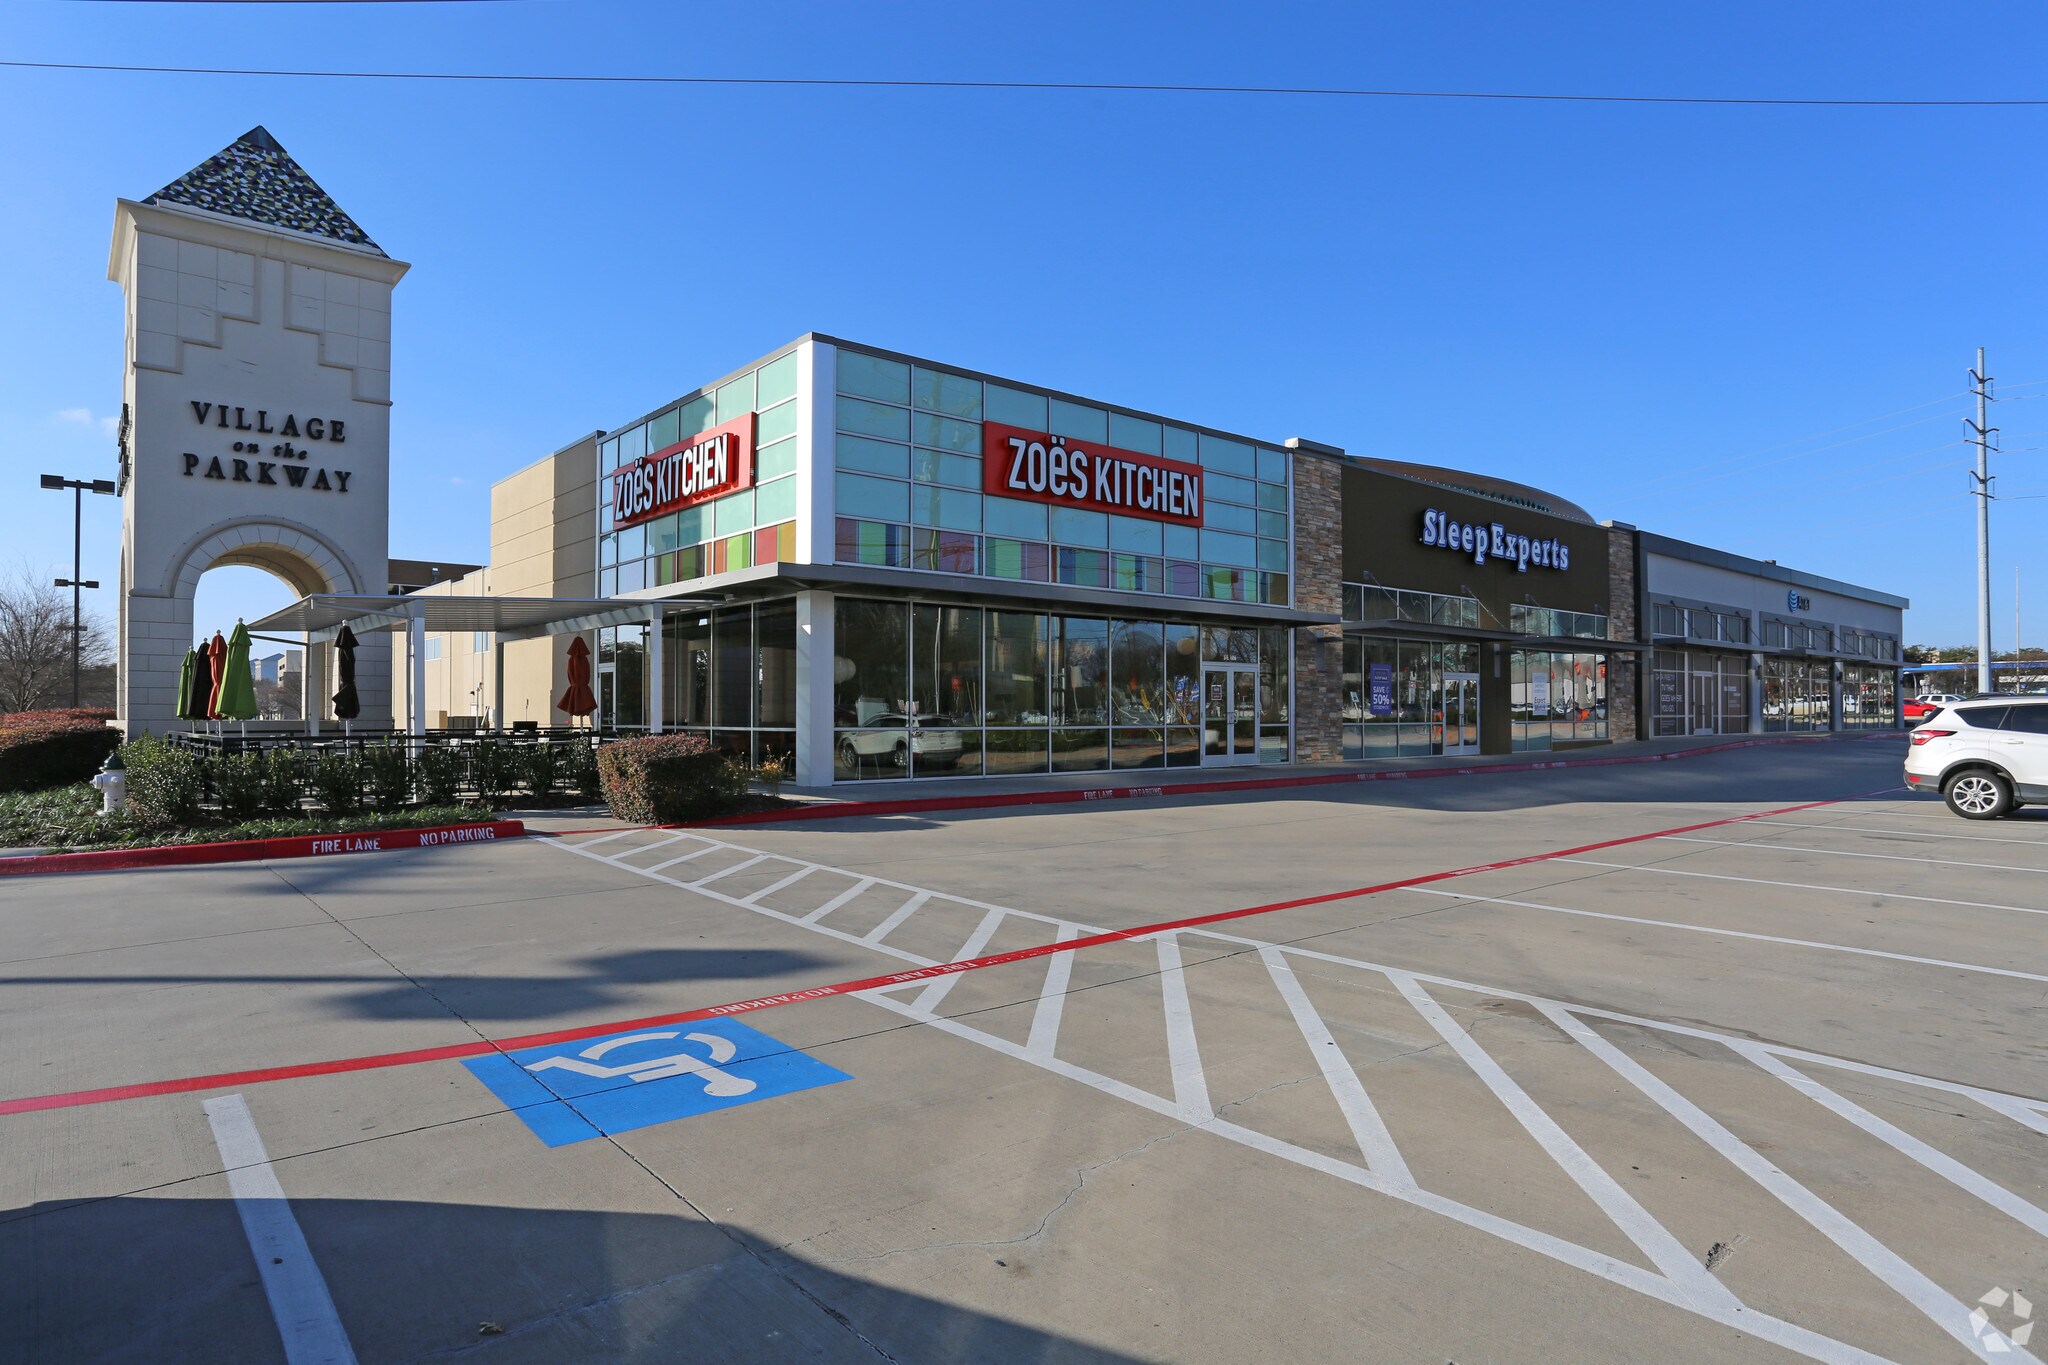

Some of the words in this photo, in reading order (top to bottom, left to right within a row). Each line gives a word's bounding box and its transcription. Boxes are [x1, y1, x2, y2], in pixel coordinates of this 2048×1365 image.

[191, 401, 346, 442] VILLAGE
[233, 441, 260, 453] on
[273, 442, 308, 460] the
[183, 453, 351, 492] PARKWAY
[656, 432, 730, 506] KITCHEN
[1095, 455, 1199, 518] KITCHEN
[1373, 694, 1390, 705] 50%
[312, 839, 342, 854] FIRE
[346, 837, 381, 851] LANE
[420, 832, 438, 846] NO
[441, 826, 495, 843] PARKING
[708, 993, 804, 1015] PARKING
